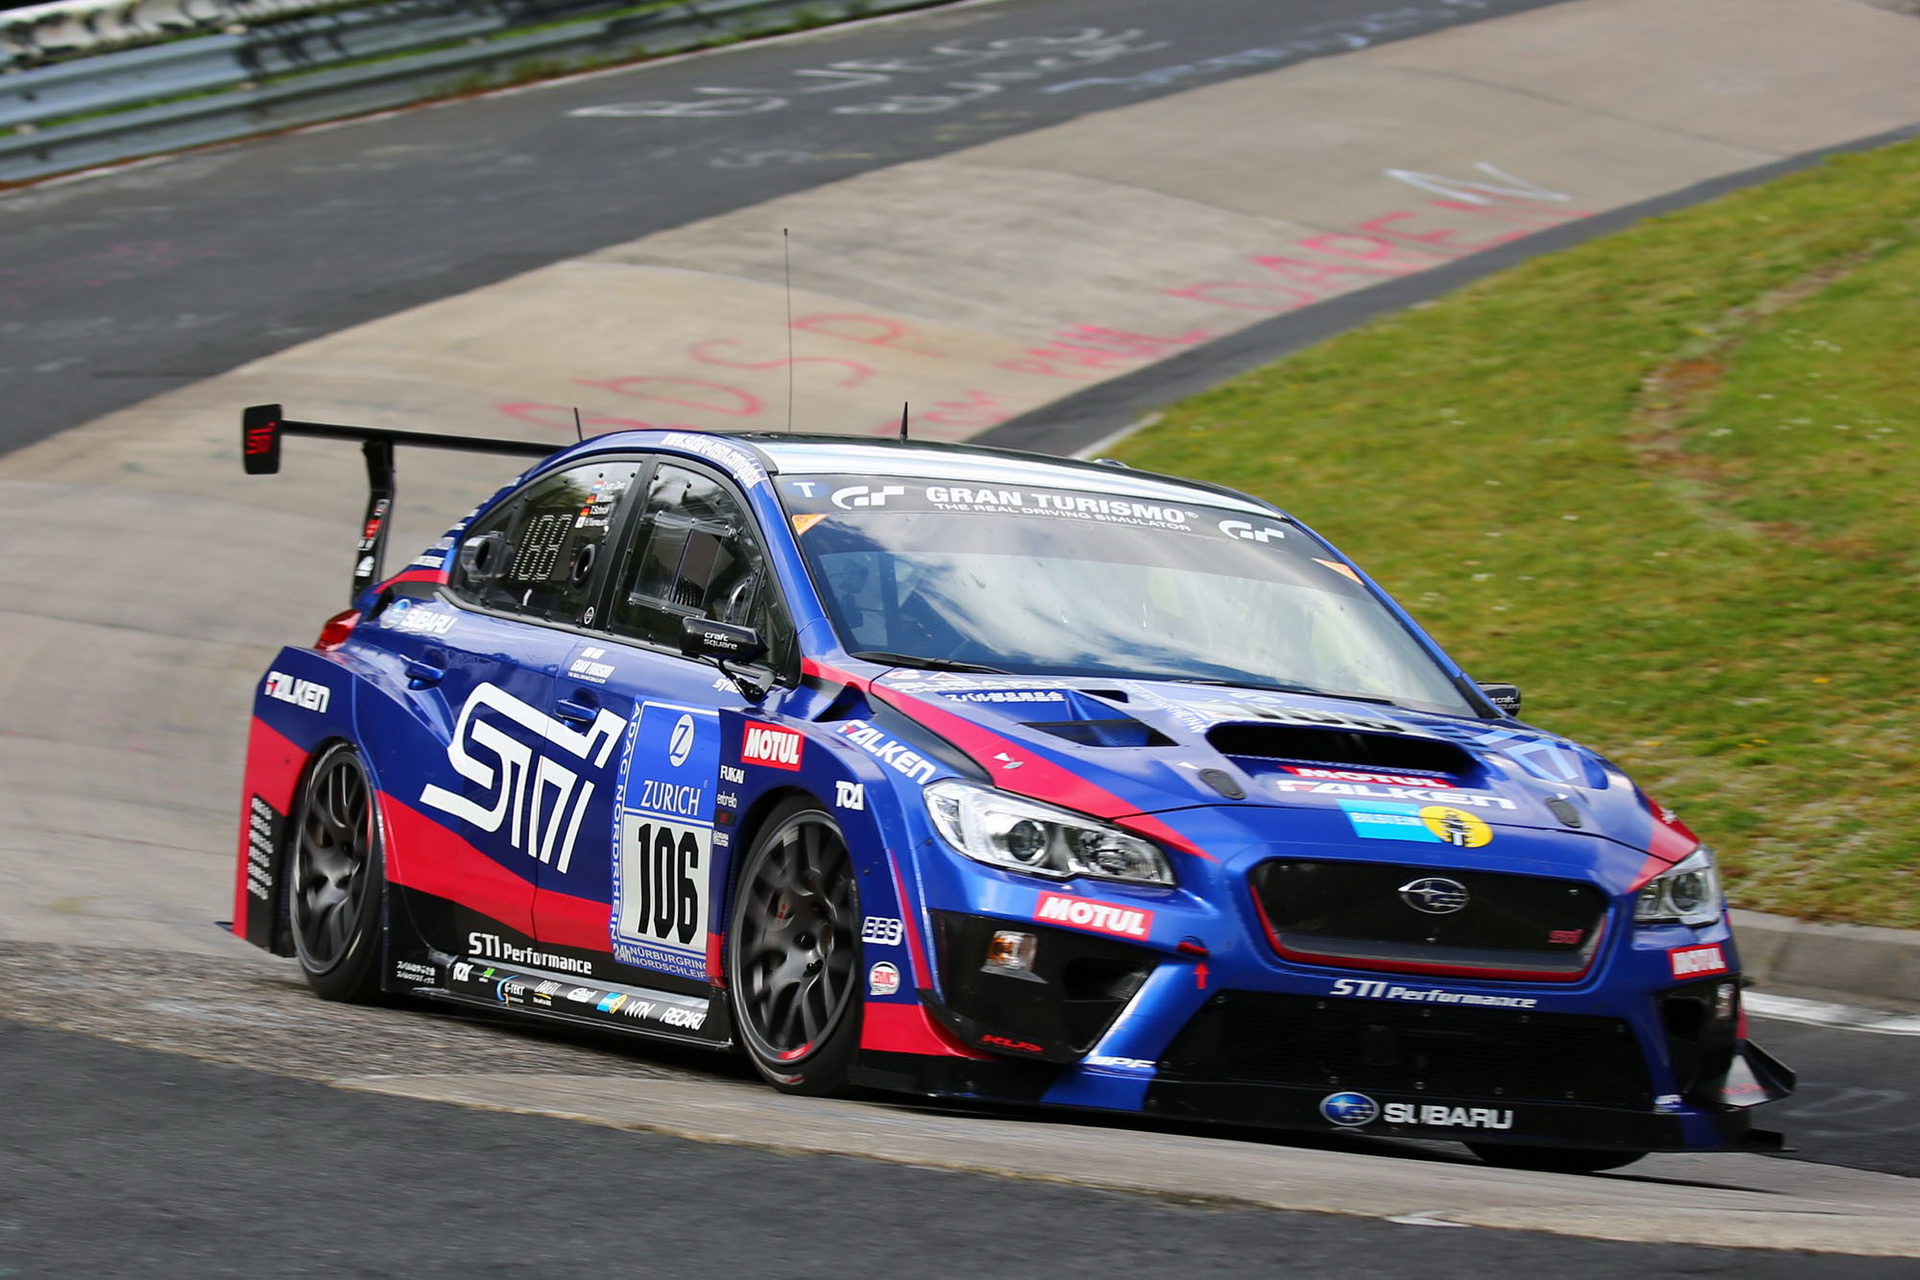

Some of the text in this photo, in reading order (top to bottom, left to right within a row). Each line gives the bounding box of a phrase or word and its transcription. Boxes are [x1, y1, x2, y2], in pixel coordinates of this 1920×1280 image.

[793, 482, 815, 498] T
[926, 486, 1023, 506] GRAN
[935, 502, 1192, 532] THE REAL DRIVING SIMULATOR
[400, 609, 458, 634] SUBARU
[703, 638, 738, 651] square
[264, 671, 330, 714] FALKEN
[743, 727, 801, 765] MOTUL
[836, 719, 937, 785] FALKEN
[720, 764, 745, 785] FUKAI
[1294, 767, 1450, 788] MOTUL
[640, 780, 702, 816] ZURICH
[1275, 780, 1518, 810] FALKEN
[609, 702, 641, 942] ADAC NORDRHEIN
[637, 822, 700, 945] 106
[1037, 897, 1146, 936] MOTUL
[468, 932, 592, 975] STI Performance
[612, 942, 632, 964] 24h
[1672, 949, 1727, 976] MOTUL
[1329, 978, 1538, 1009] STI Performance
[623, 1000, 655, 1020] NTN
[658, 1006, 708, 1031] RECARO
[1383, 1102, 1514, 1130] SUBARU
